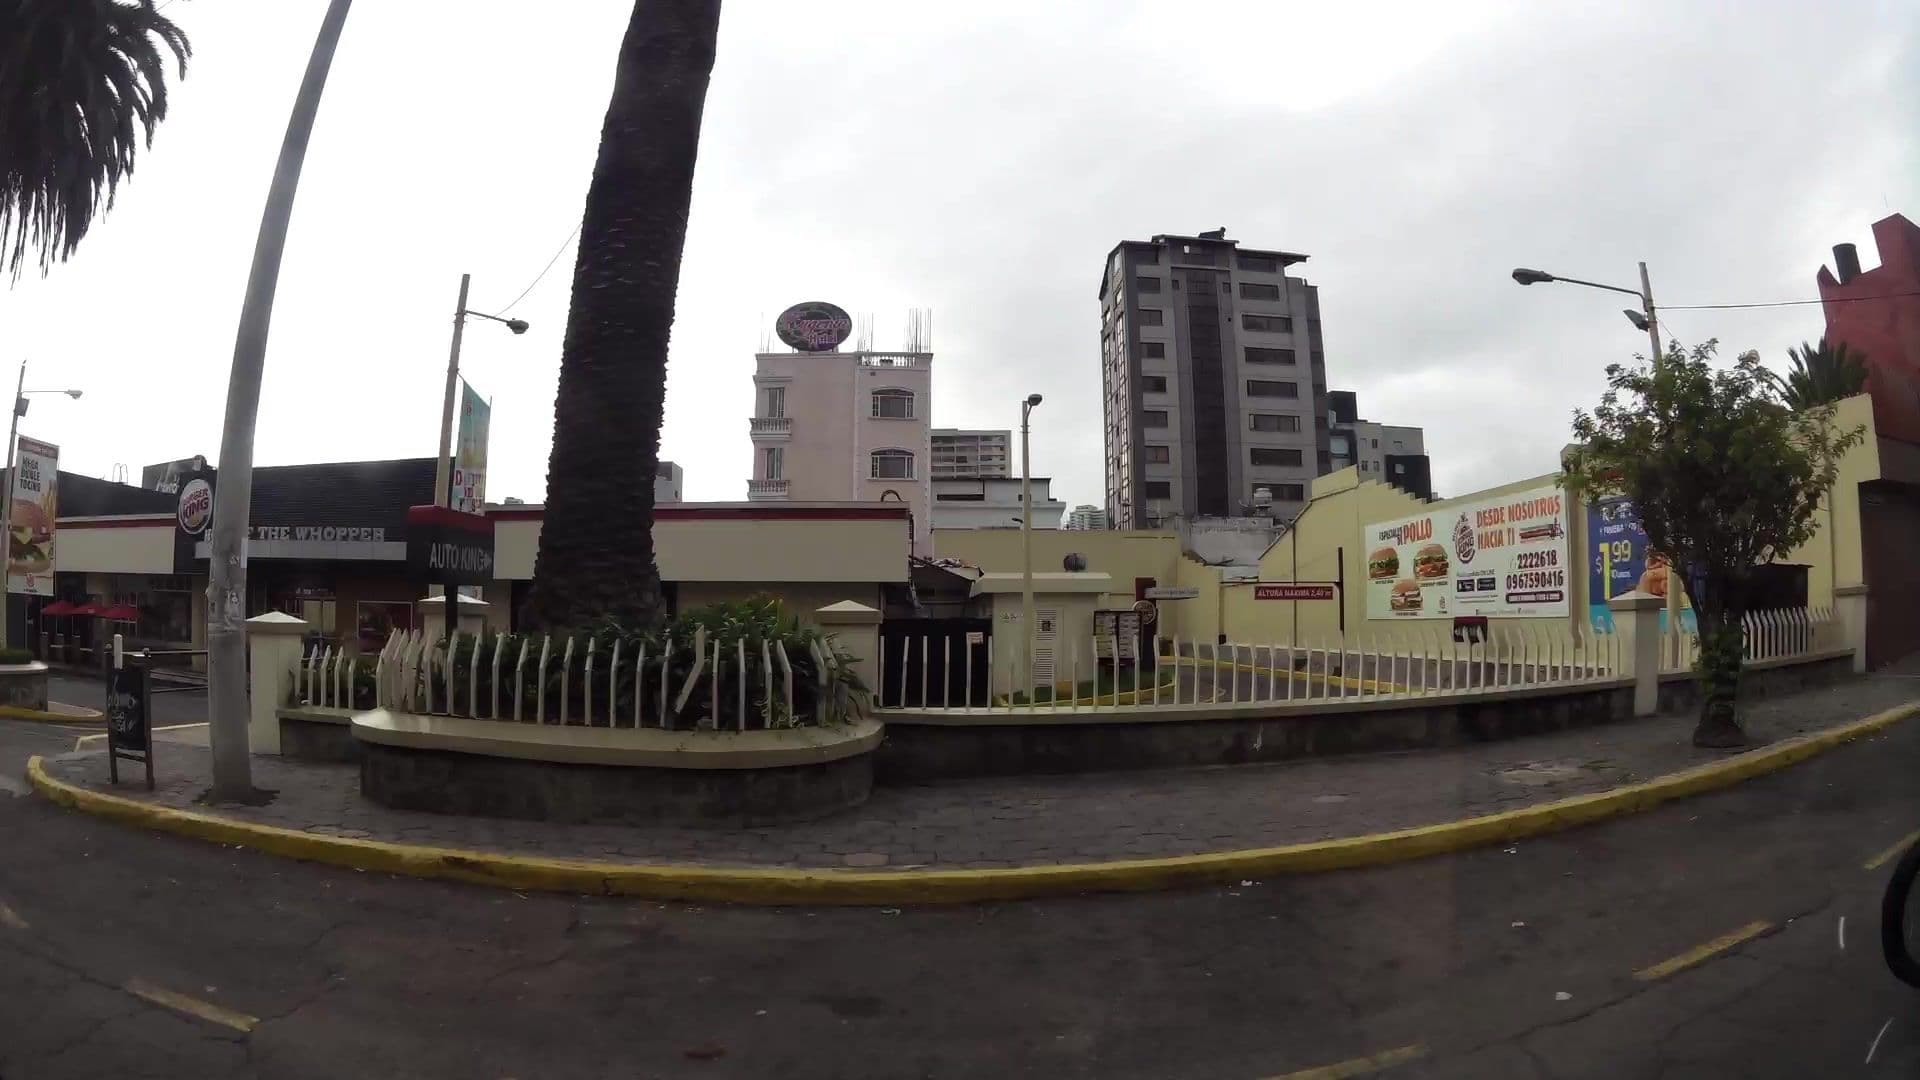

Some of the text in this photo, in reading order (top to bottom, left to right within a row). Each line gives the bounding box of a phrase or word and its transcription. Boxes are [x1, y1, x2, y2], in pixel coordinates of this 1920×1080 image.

[184, 488, 208, 504] BURGER
[182, 497, 208, 520] KING
[1477, 495, 1560, 528] DESDE NOSOTROS
[258, 527, 290, 540] THE
[295, 527, 385, 542] WHOPPER
[1403, 518, 1432, 544] POLLO
[1477, 529, 1504, 550] HACIA
[1507, 528, 1515, 545] TI
[429, 542, 484, 570] AUTO KING
[1517, 550, 1557, 569] 2222618
[1506, 571, 1563, 590] 0967590416
